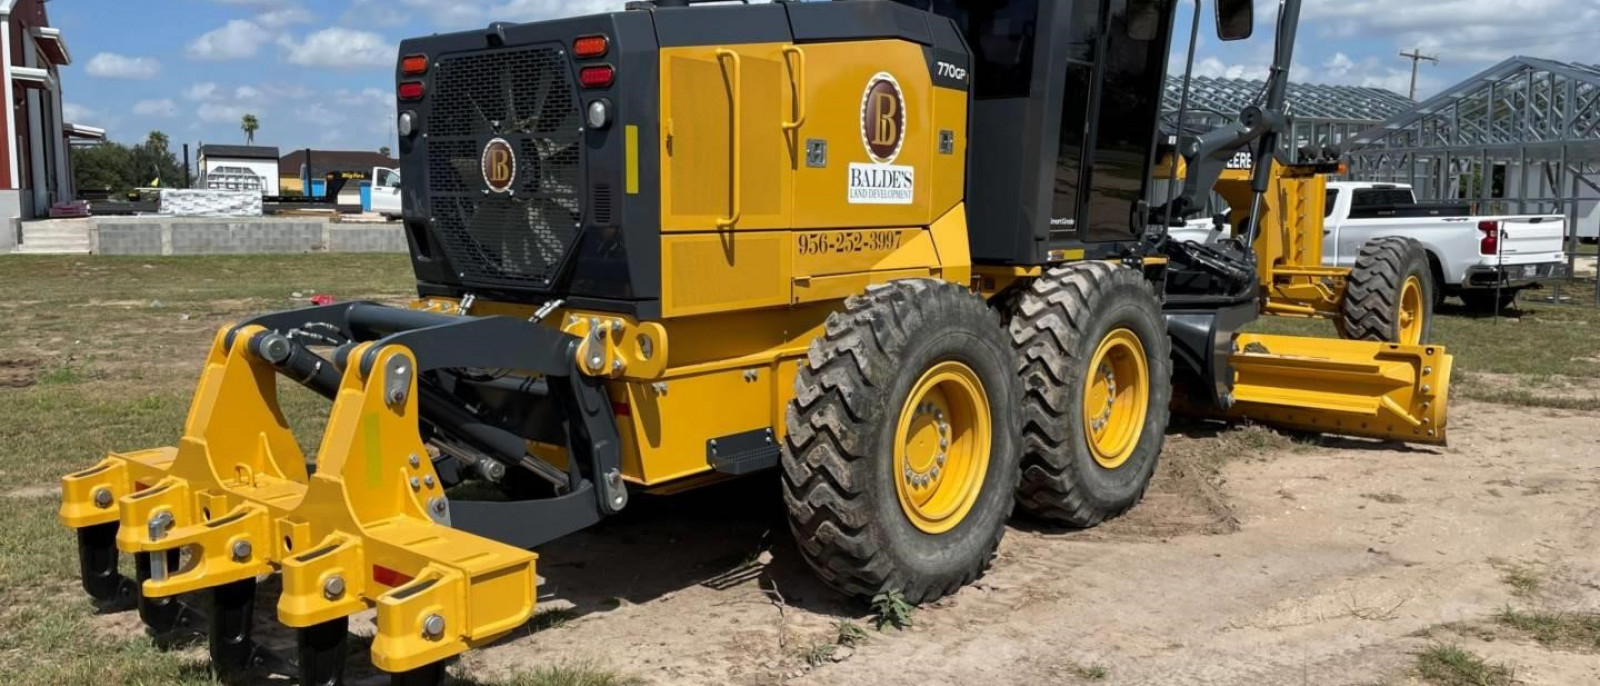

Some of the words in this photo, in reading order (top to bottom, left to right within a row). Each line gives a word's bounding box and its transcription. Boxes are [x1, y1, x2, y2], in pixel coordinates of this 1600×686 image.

[937, 62, 966, 79] 770GP
[1227, 152, 1252, 169] EERE
[851, 168, 912, 188] BALDE'S
[850, 189, 867, 198] LAND
[868, 189, 912, 199] DEVELOPMENT
[798, 231, 902, 255] 956-252-3997
